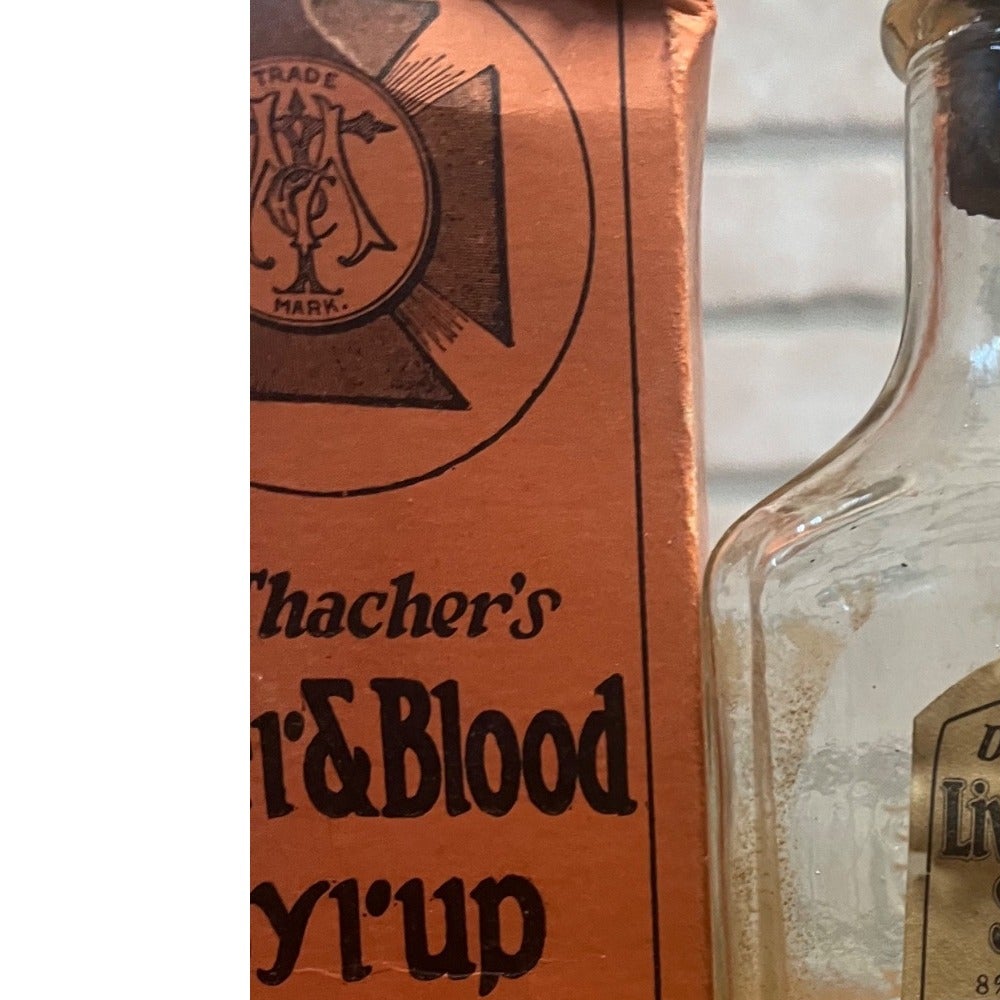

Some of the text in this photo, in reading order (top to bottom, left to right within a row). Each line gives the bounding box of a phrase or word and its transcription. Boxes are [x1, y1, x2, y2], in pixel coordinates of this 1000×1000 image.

[252, 67, 338, 90] TRADE
[274, 298, 348, 316] MARK.
[250, 673, 638, 819] r&Blood
